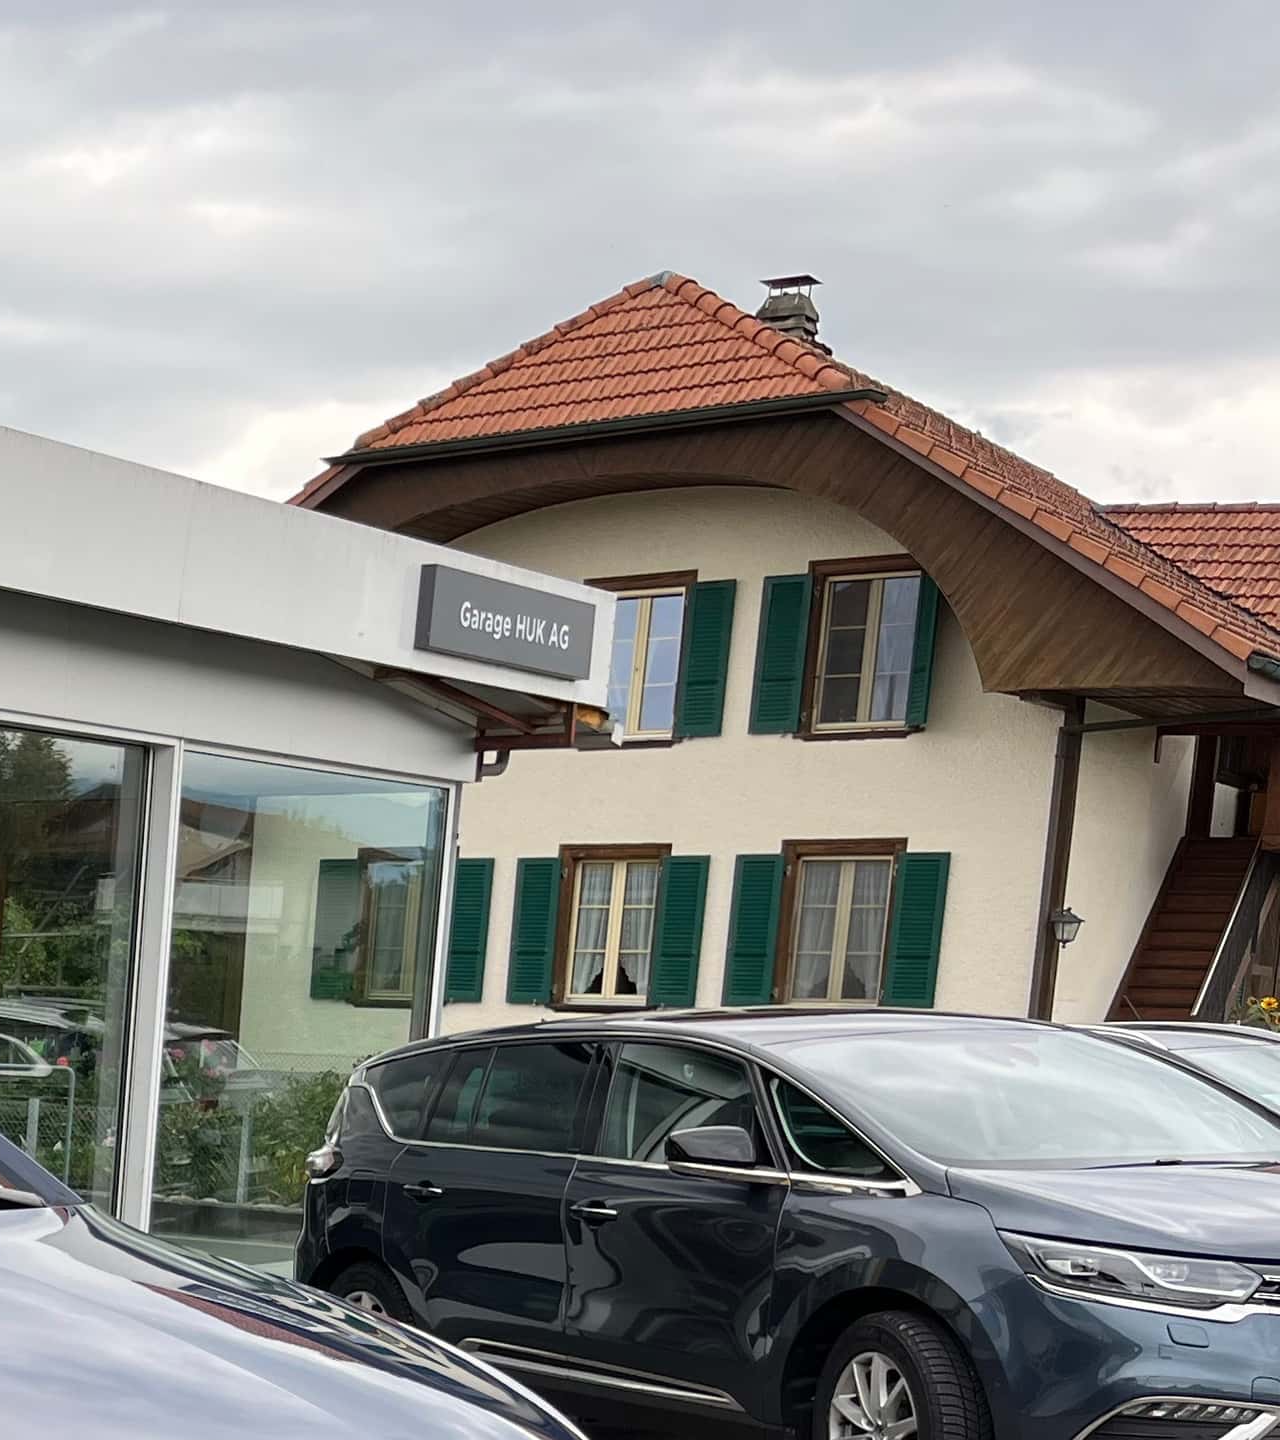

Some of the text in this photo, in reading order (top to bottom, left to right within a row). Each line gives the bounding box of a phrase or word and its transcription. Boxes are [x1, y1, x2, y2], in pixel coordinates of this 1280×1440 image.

[460, 600, 570, 650] Garage HUK AG
